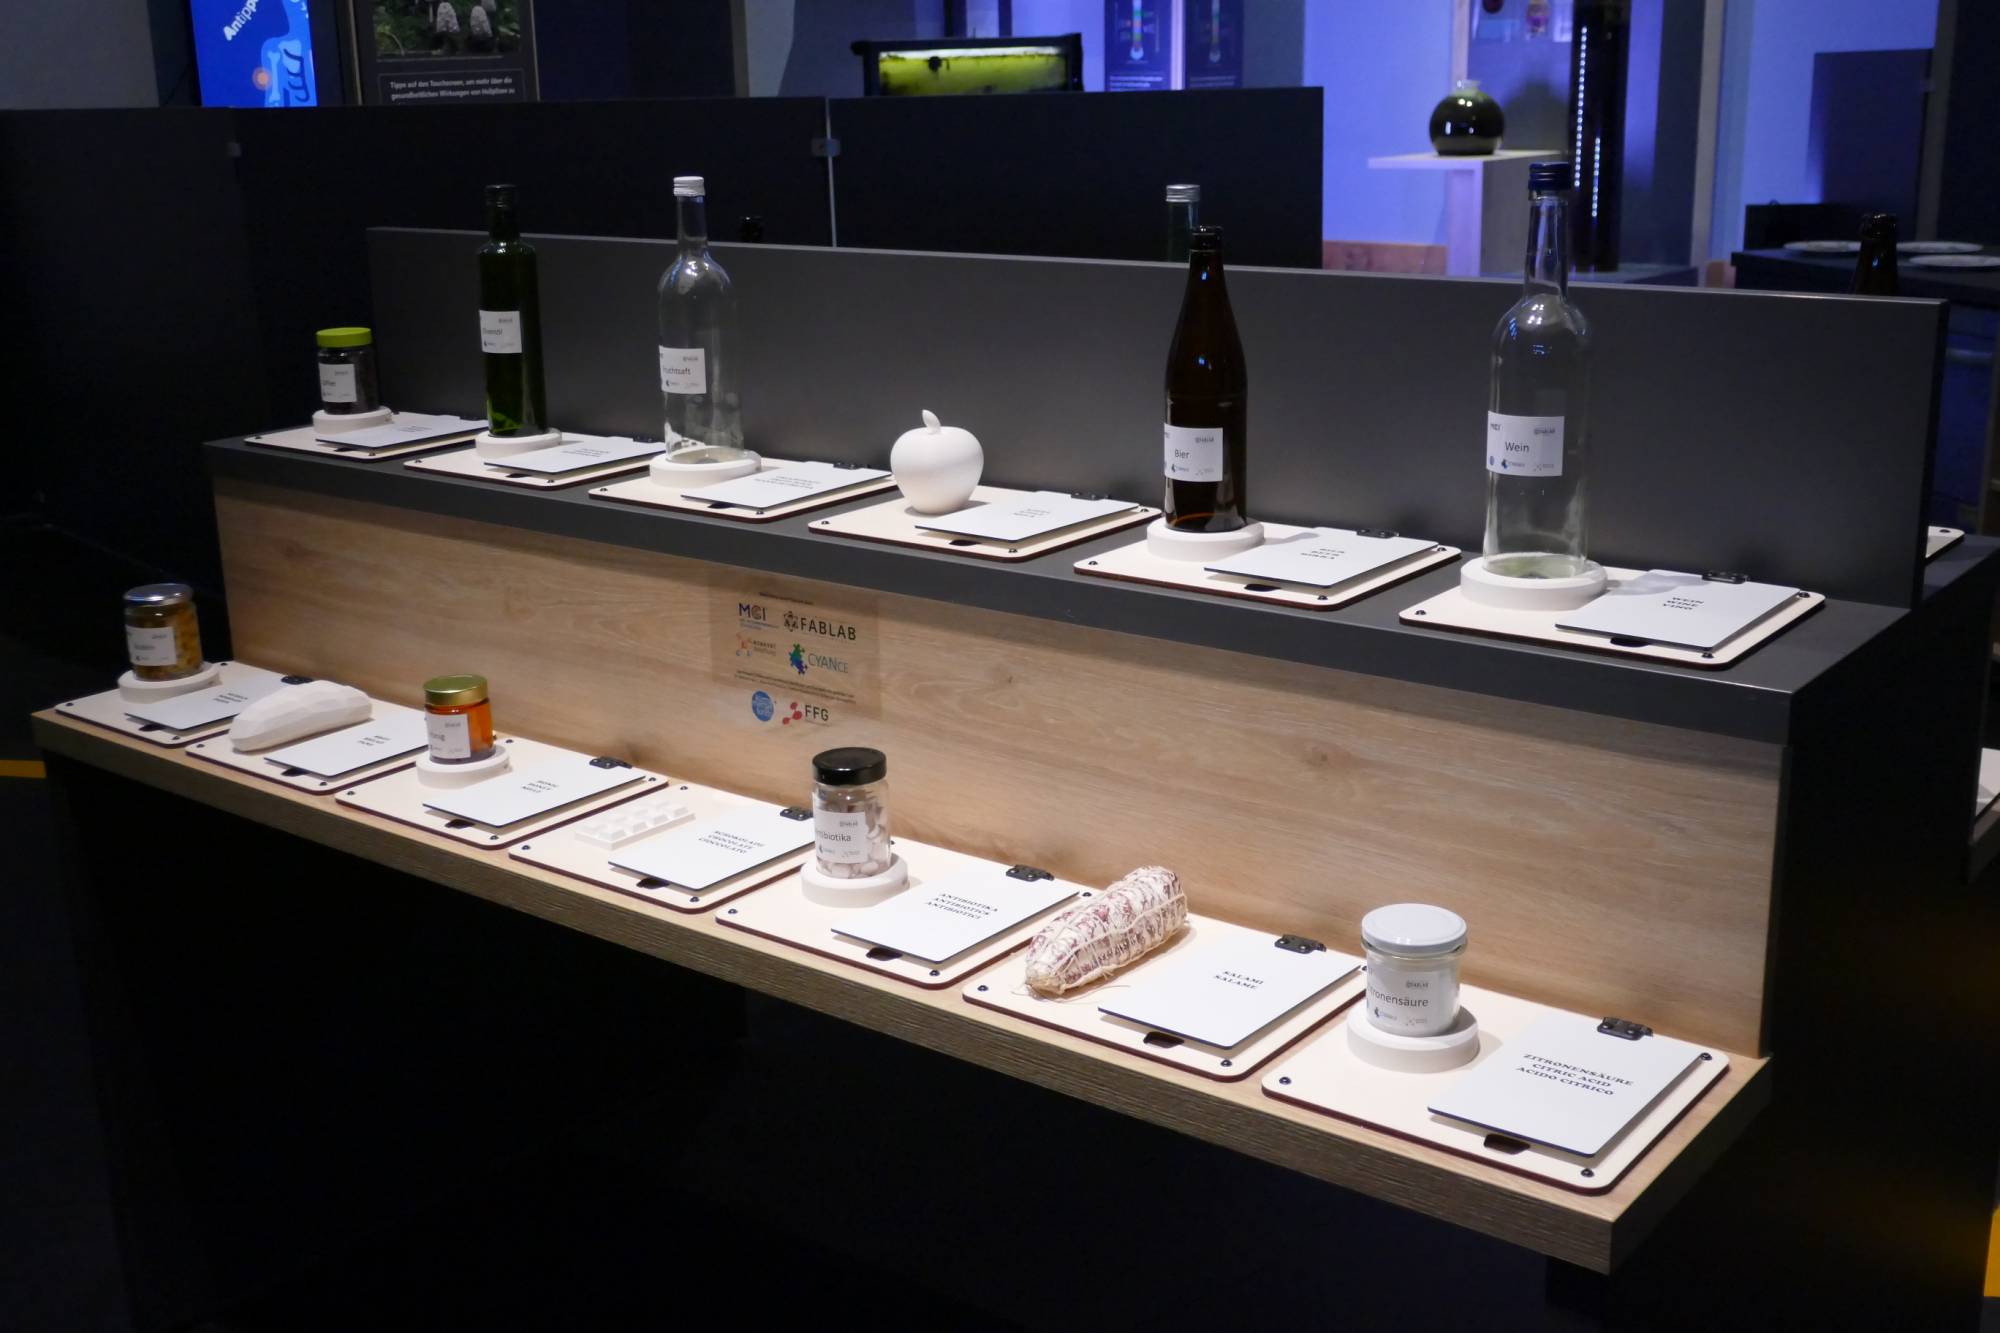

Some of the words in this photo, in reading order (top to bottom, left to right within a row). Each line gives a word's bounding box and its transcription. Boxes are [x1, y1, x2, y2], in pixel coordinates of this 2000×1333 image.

[1174, 449, 1190, 459] Bier
[1505, 442, 1530, 453] Wein
[738, 602, 767, 621] MCI
[800, 617, 857, 641] FABLAB
[804, 704, 830, 721] FFG
[933, 898, 989, 915] ANTIBIOTICS
[940, 893, 998, 912] ANTIBIOTIKA
[1523, 1053, 1634, 1086] ZITRONENSÄURE
[1532, 1063, 1577, 1078] CITRIC
[1578, 1076, 1612, 1087] ACID
[1516, 1066, 1558, 1080] ACIDO
[1560, 1078, 1614, 1096] CITRICO
